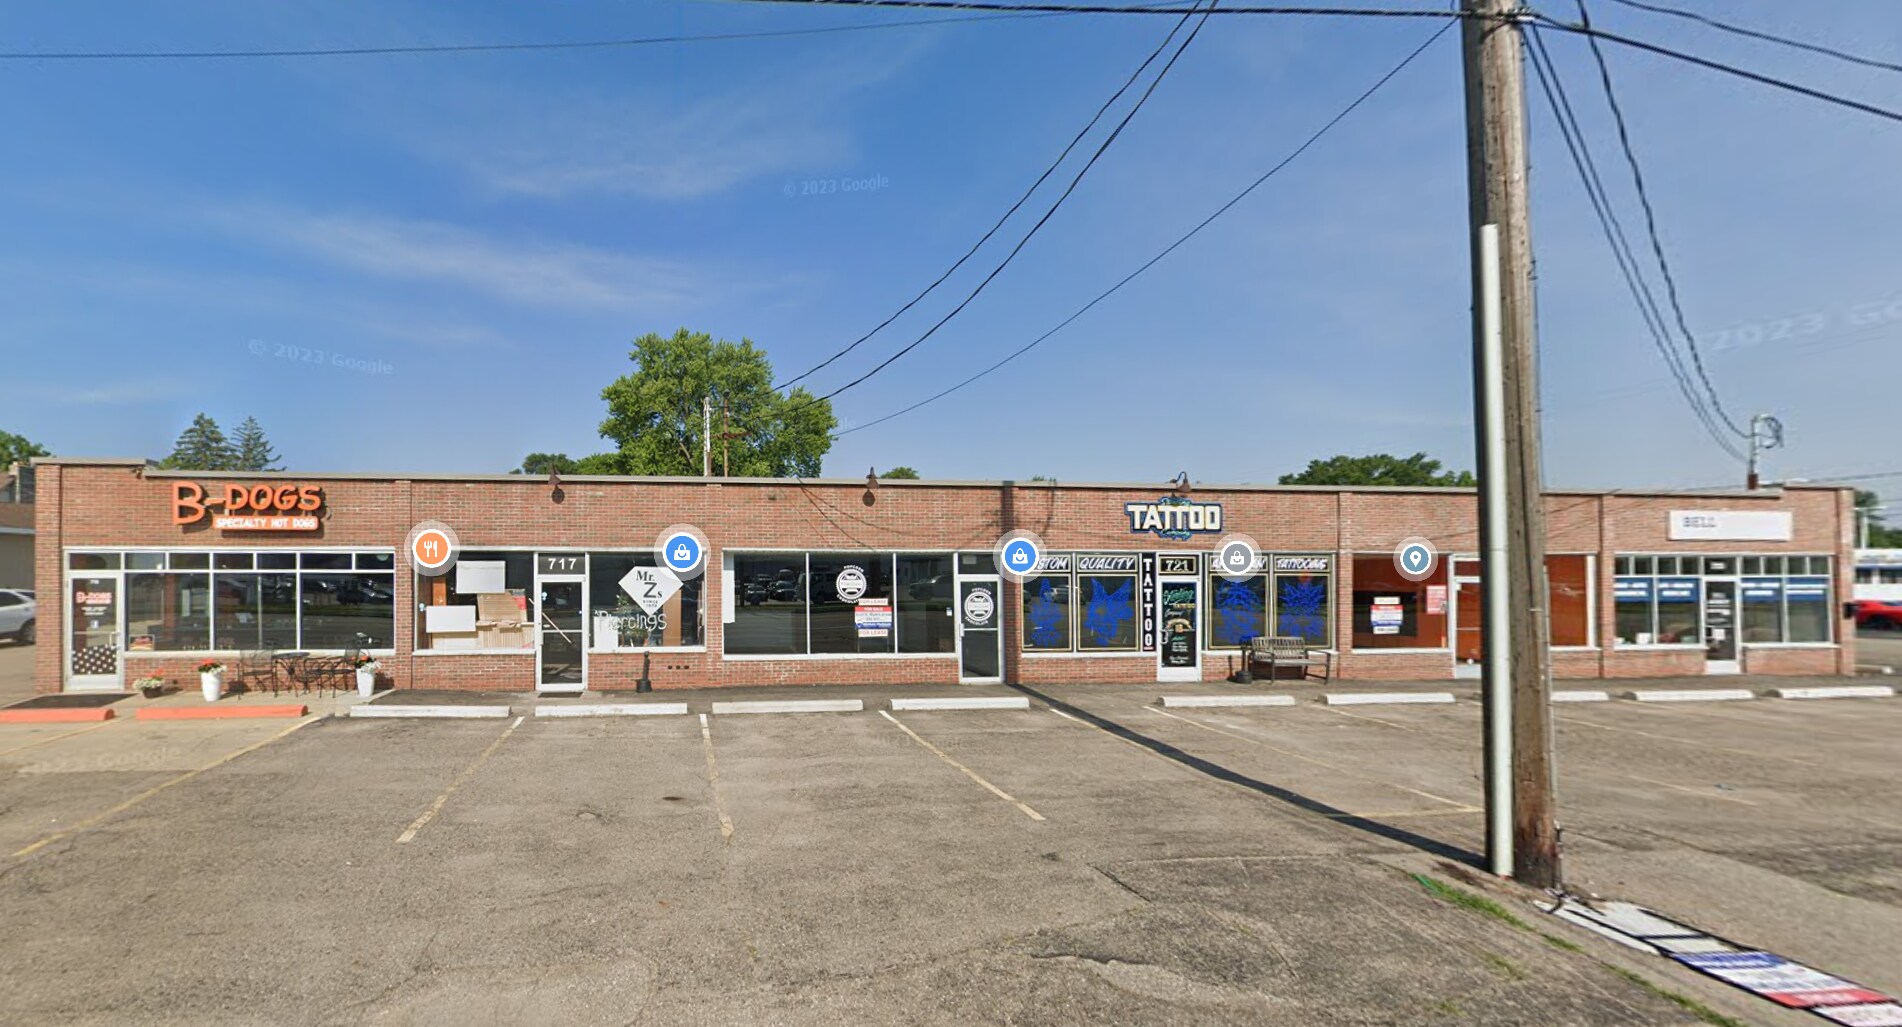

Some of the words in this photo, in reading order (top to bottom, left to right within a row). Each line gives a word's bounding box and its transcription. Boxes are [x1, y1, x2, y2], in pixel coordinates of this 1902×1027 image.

[172, 481, 322, 524] B-DOGS
[215, 518, 266, 528] SPECIALTY
[271, 518, 288, 528] HOT
[292, 518, 316, 528] DOGS
[1127, 505, 1221, 530] TATTOO
[548, 558, 577, 570] 717
[1079, 557, 1134, 570] QUALITY
[1165, 559, 1189, 571] 721
[636, 570, 655, 581] Mr.
[1143, 558, 1153, 647] TATTOO
